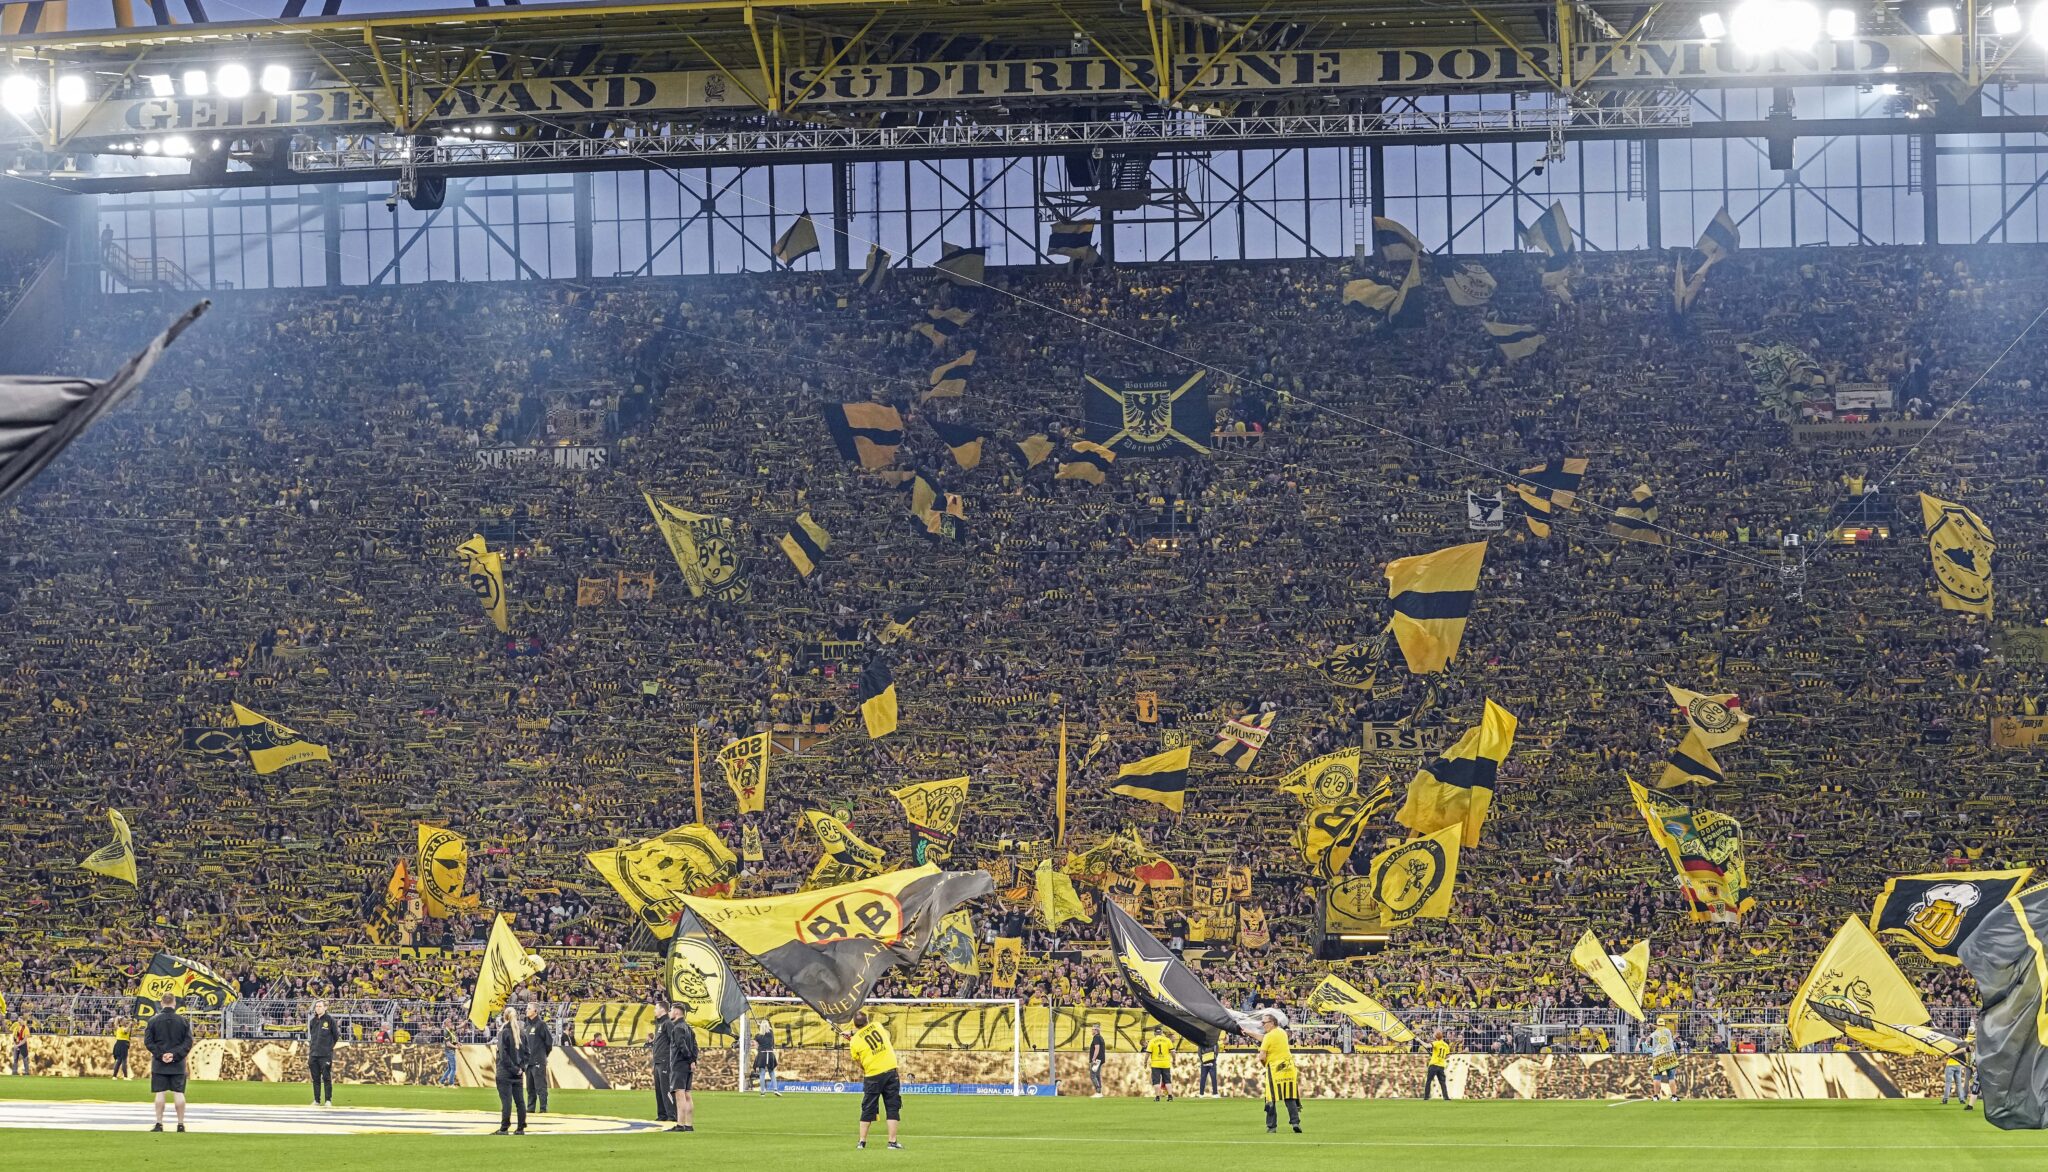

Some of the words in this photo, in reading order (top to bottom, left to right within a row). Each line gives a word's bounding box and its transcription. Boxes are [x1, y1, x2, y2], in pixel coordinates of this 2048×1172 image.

[124, 91, 374, 130] GELBE
[423, 76, 657, 117] WAND
[1377, 41, 1890, 82] DORTMUND
[1124, 381, 1168, 389] Borussia
[1123, 438, 1174, 452] Dortmund
[1166, 732, 1180, 745] BVB
[1375, 728, 1440, 749] BSW
[1695, 814, 1708, 827] 19
[818, 942, 890, 1015] RHEIN-AH
[151, 979, 174, 992] BVB
[914, 1006, 1031, 1050] ZUM
[864, 1030, 884, 1051] 09
[1157, 1044, 1162, 1055] 1
[1438, 1047, 1446, 1059] 11
[900, 1084, 952, 1094] nanderda
[976, 1087, 1001, 1095] SIGNAL
